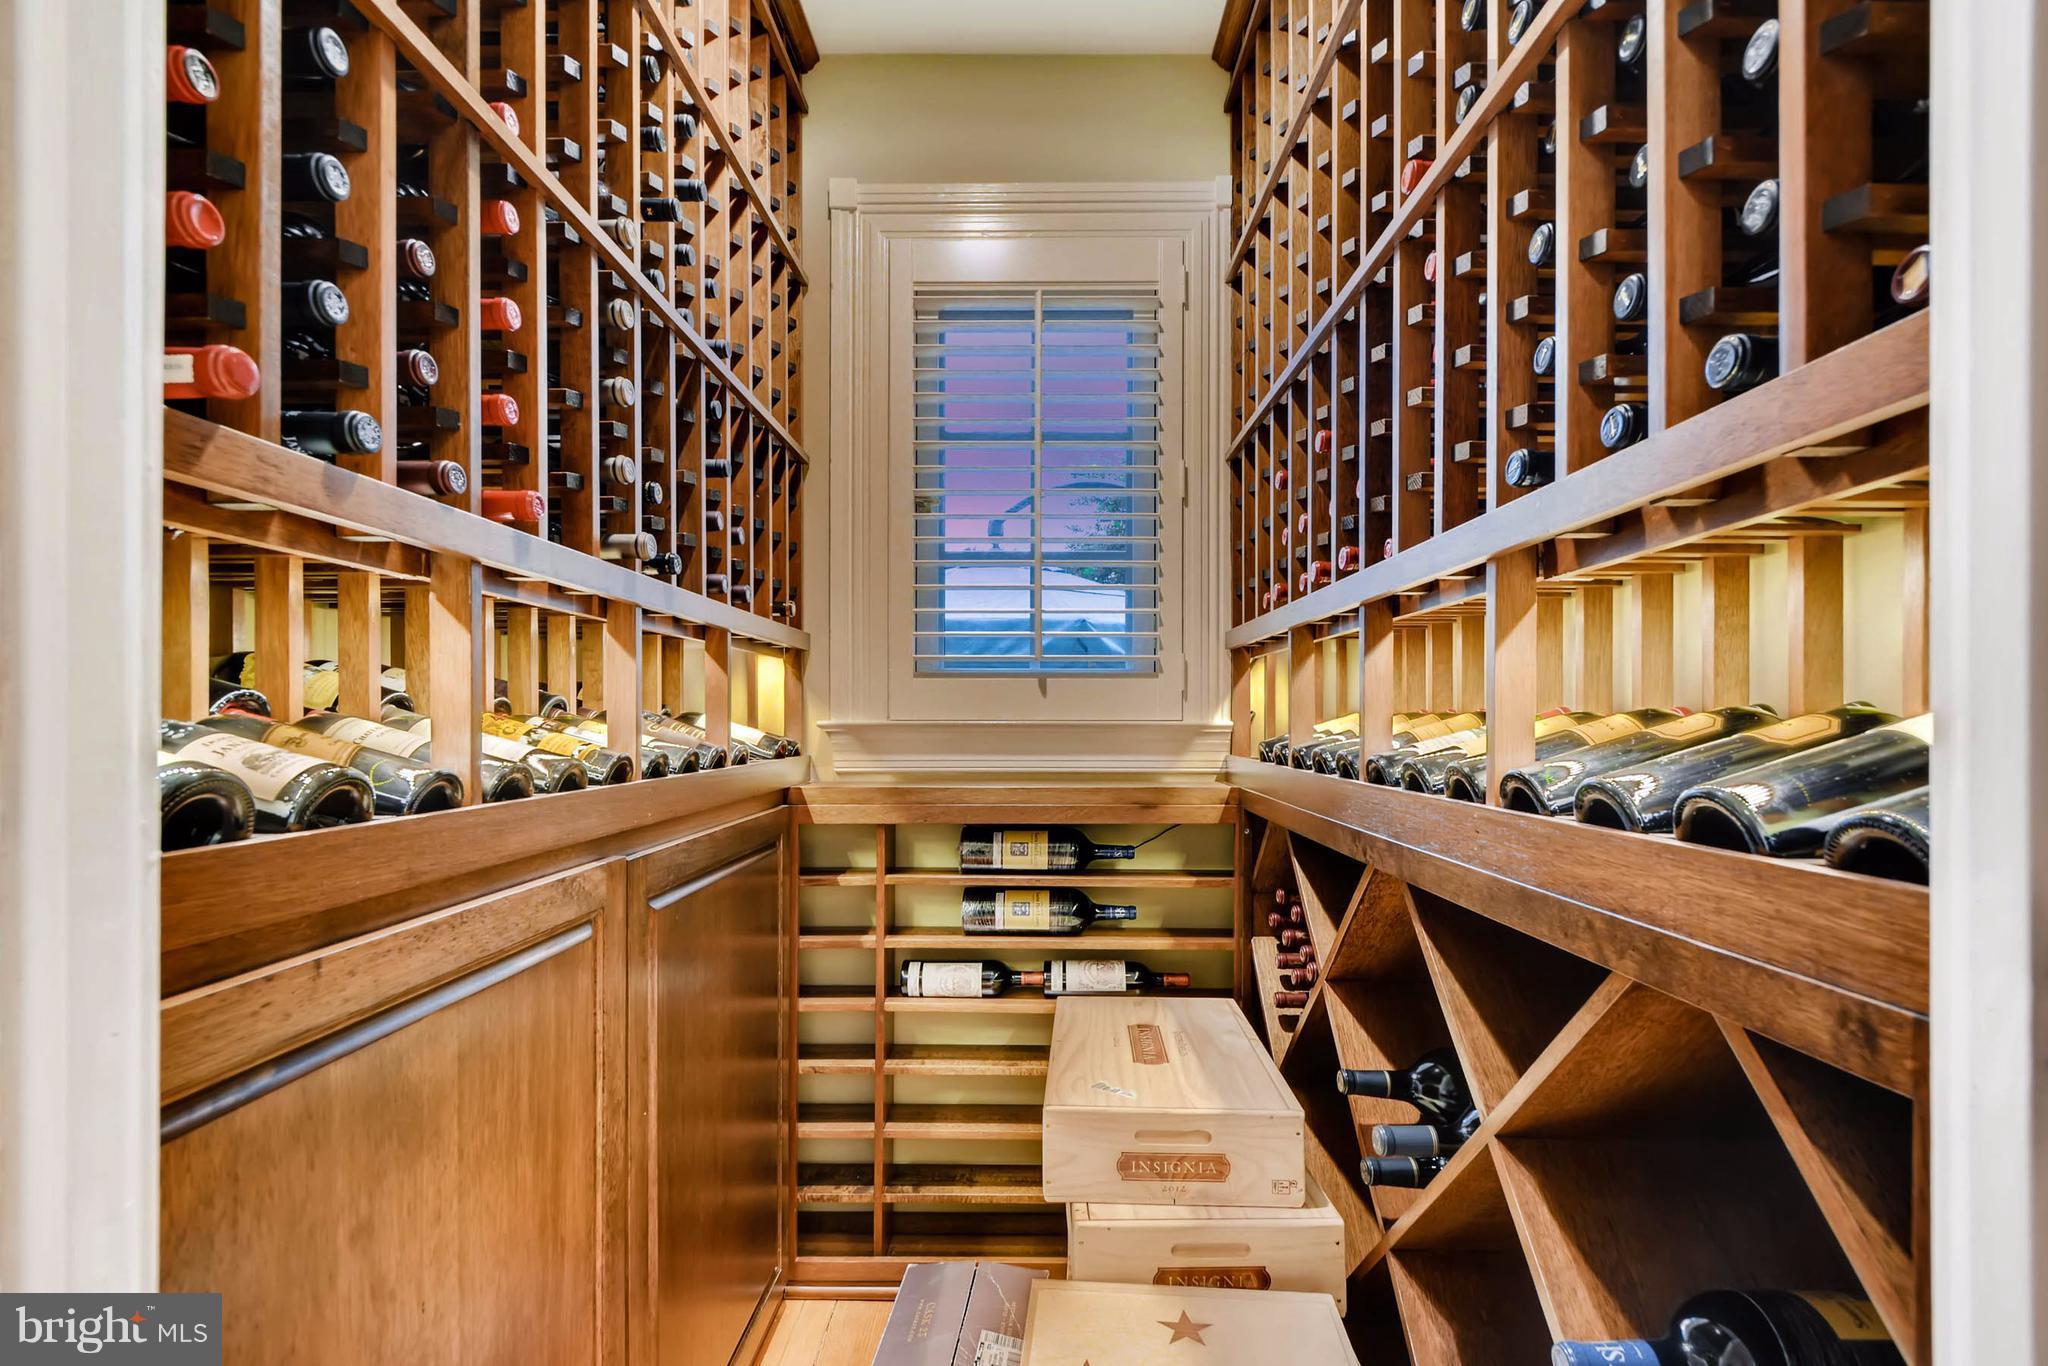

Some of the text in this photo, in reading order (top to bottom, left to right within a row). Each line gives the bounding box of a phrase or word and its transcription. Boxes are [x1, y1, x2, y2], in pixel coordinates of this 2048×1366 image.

[1137, 1028, 1156, 1060] INSIGNIA
[1131, 1160, 1217, 1175] INSIGNIA
[1168, 1272, 1257, 1289] INSIGNIA
